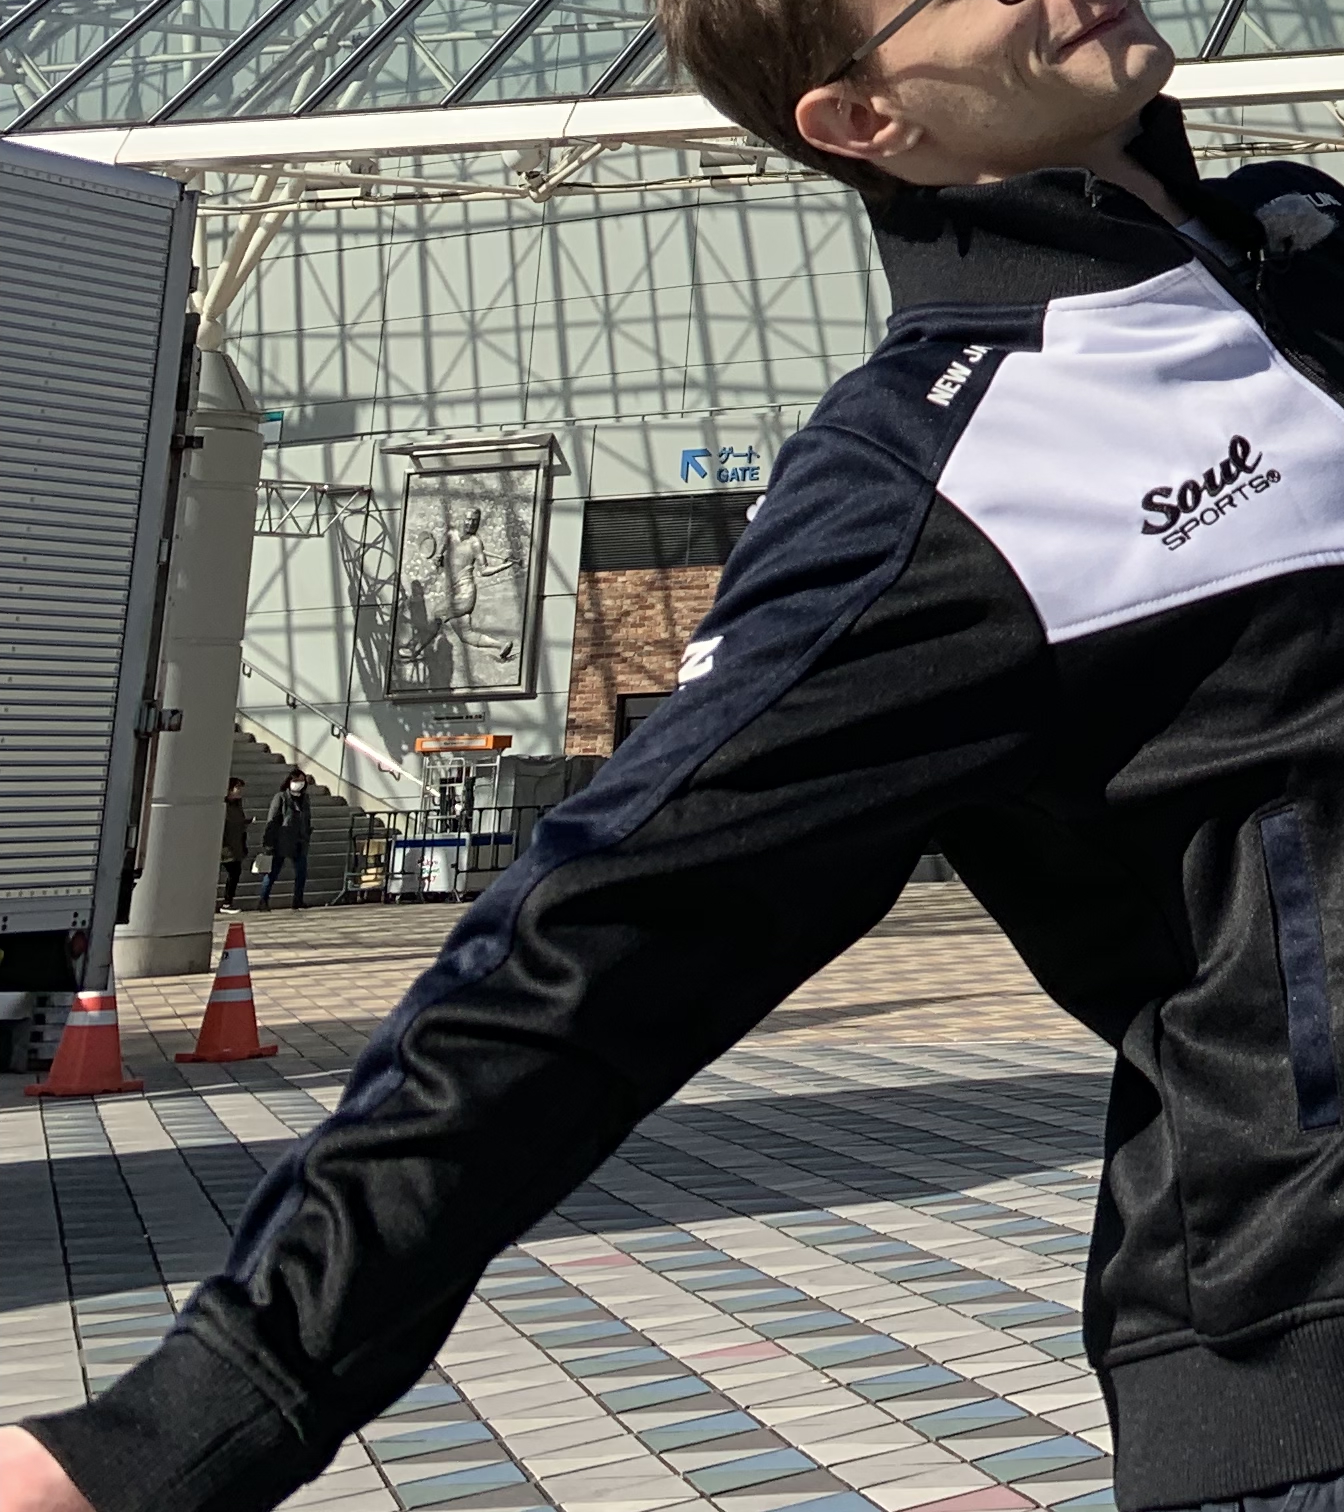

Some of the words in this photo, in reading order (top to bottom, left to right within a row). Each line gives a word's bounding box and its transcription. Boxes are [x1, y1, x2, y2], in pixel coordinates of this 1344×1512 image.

[926, 360, 972, 407] NEW
[718, 445, 760, 465] ゲート
[716, 466, 761, 483] GATE
[1141, 434, 1263, 535] Soul
